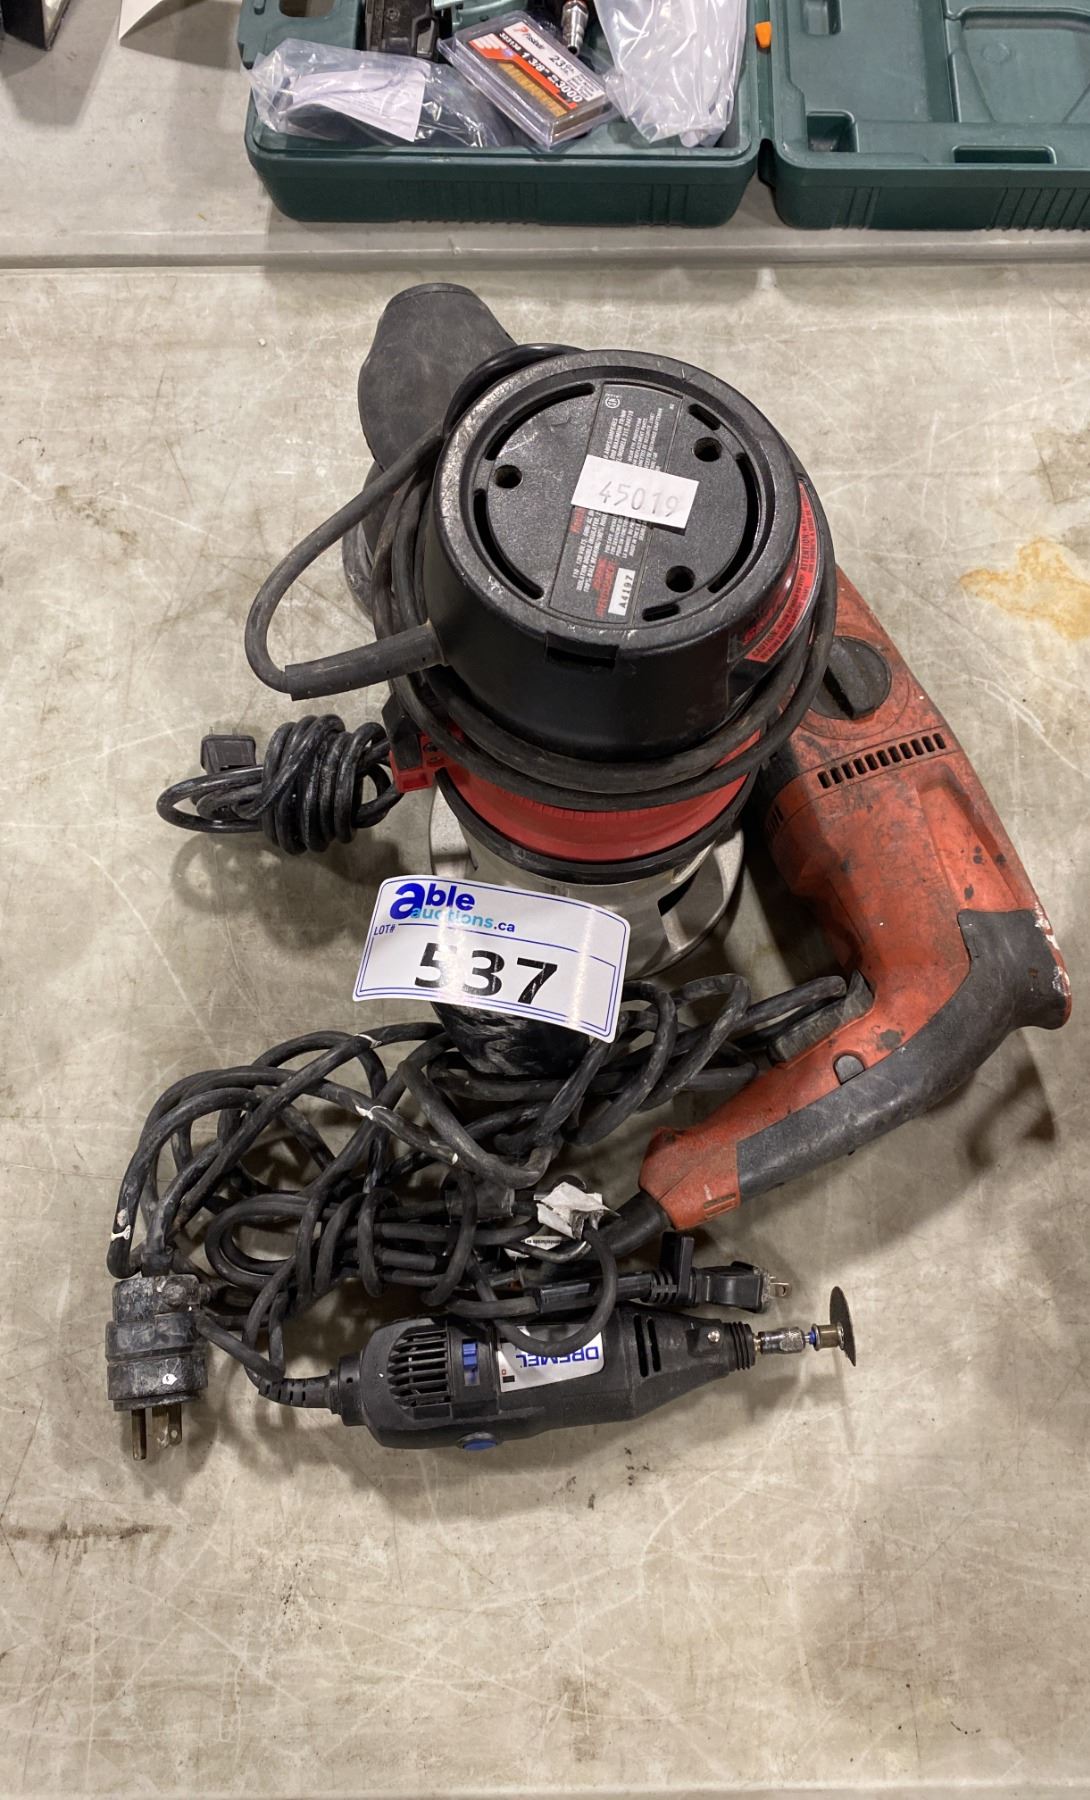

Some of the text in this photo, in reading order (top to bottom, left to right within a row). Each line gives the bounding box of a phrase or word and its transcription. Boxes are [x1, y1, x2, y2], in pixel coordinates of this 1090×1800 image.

[599, 481, 679, 517] 45019
[389, 883, 475, 920] able
[374, 923, 396, 936] LOT#
[414, 942, 558, 1004] 537
